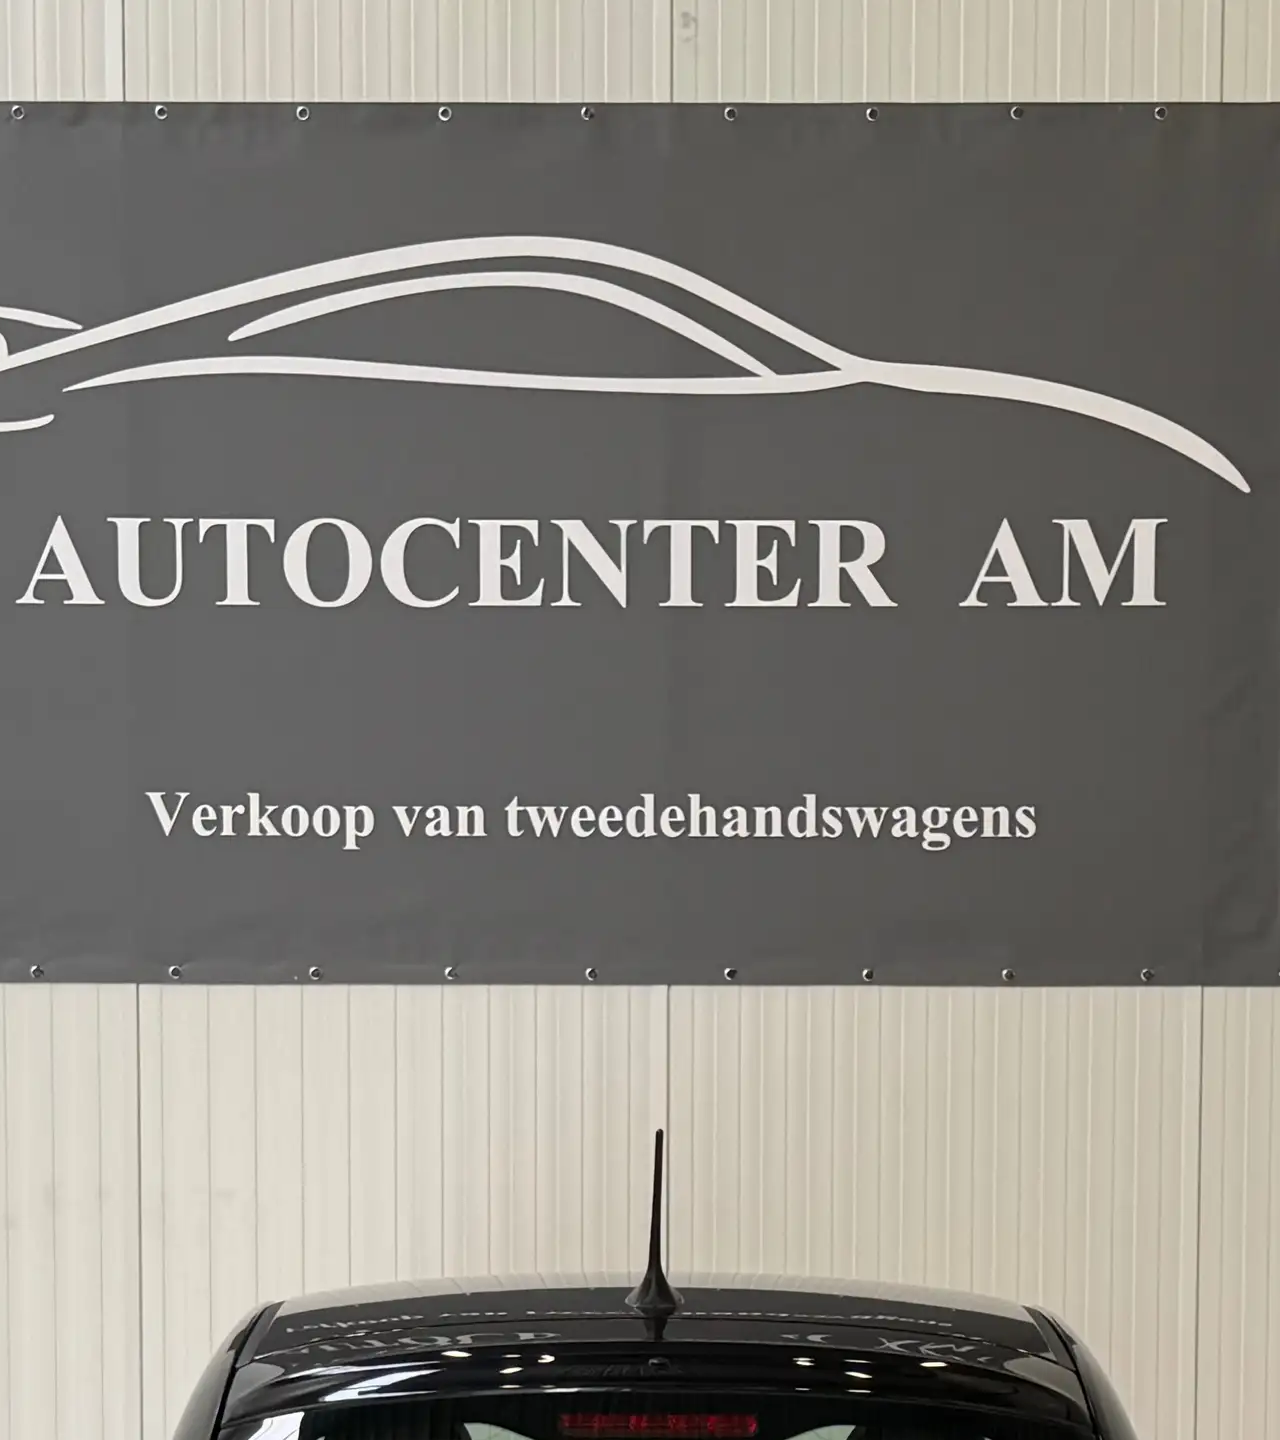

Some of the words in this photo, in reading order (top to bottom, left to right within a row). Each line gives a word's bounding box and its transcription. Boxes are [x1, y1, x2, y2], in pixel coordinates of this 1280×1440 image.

[15, 515, 899, 609] AUTOCENTER
[958, 517, 1169, 607] AM
[144, 791, 375, 851] Verkoop
[391, 804, 488, 838] van
[503, 793, 1037, 851] tweedehandswagens
